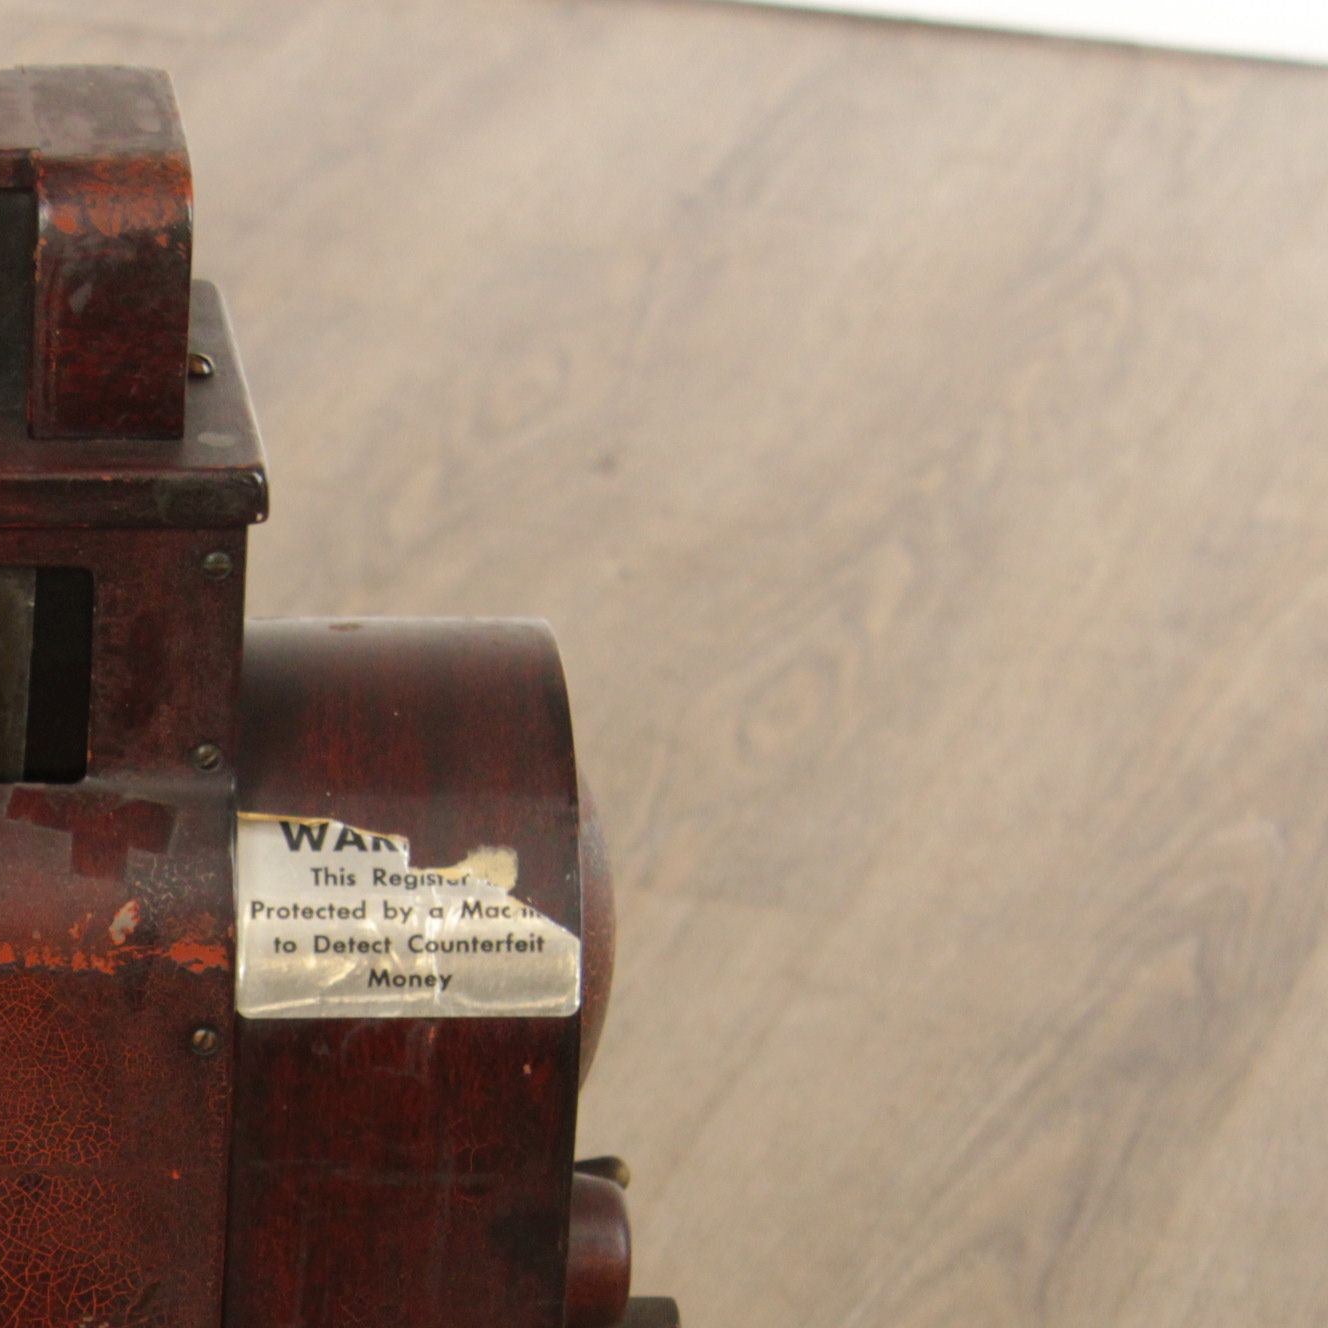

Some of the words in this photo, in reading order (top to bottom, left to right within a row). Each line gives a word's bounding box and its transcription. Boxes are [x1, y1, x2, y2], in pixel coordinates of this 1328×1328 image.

[310, 866, 356, 887] This
[250, 900, 366, 920] Protected
[383, 899, 413, 924] by
[429, 906, 443, 919] a
[274, 937, 297, 954] to
[314, 935, 391, 954] Detect
[407, 933, 545, 954] Counterfeit
[367, 968, 452, 991] Money
